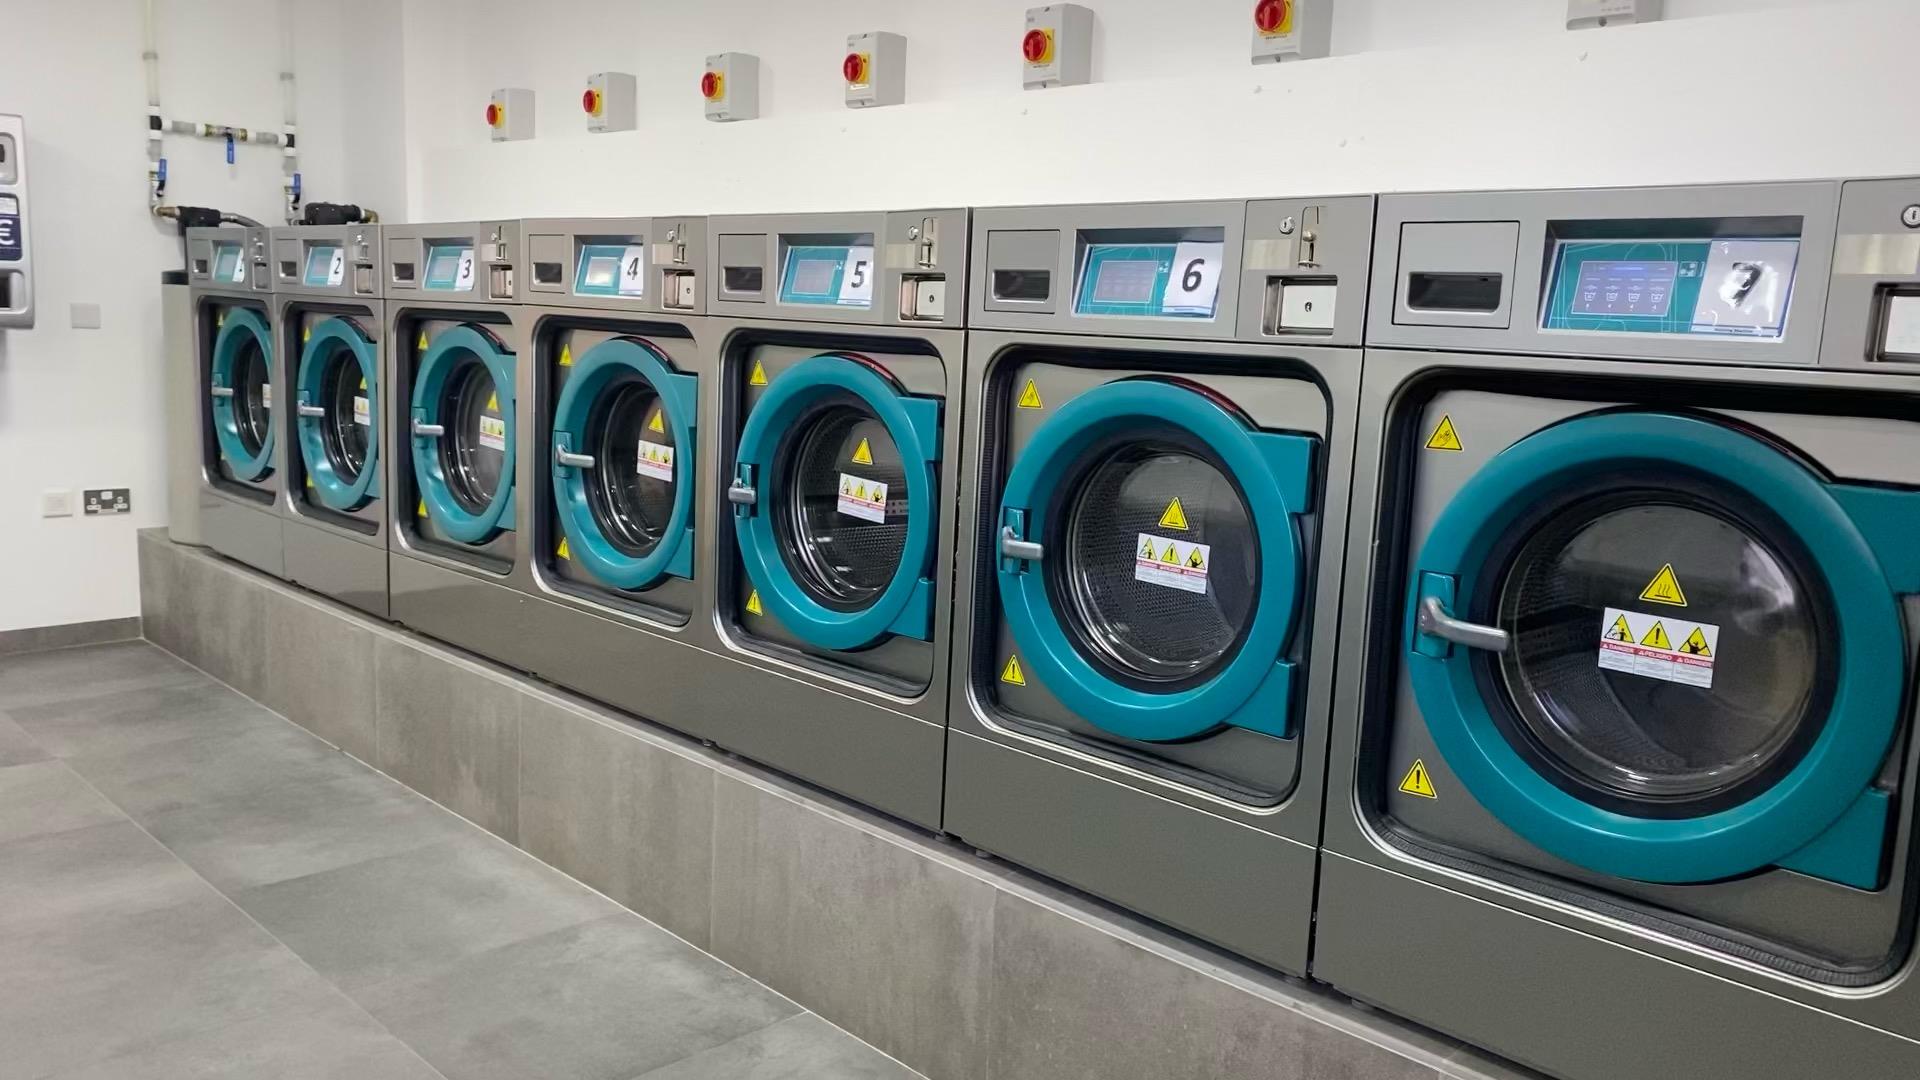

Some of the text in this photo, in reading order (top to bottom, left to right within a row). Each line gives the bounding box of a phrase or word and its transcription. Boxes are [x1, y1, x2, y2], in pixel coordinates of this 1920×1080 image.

[334, 257, 341, 274] 2
[462, 259, 472, 279] 3
[627, 257, 639, 280] 4
[851, 261, 867, 288] 5
[1182, 258, 1205, 292] 6
[1732, 261, 1762, 307] 7
[1645, 651, 1673, 660] PELIGRO
